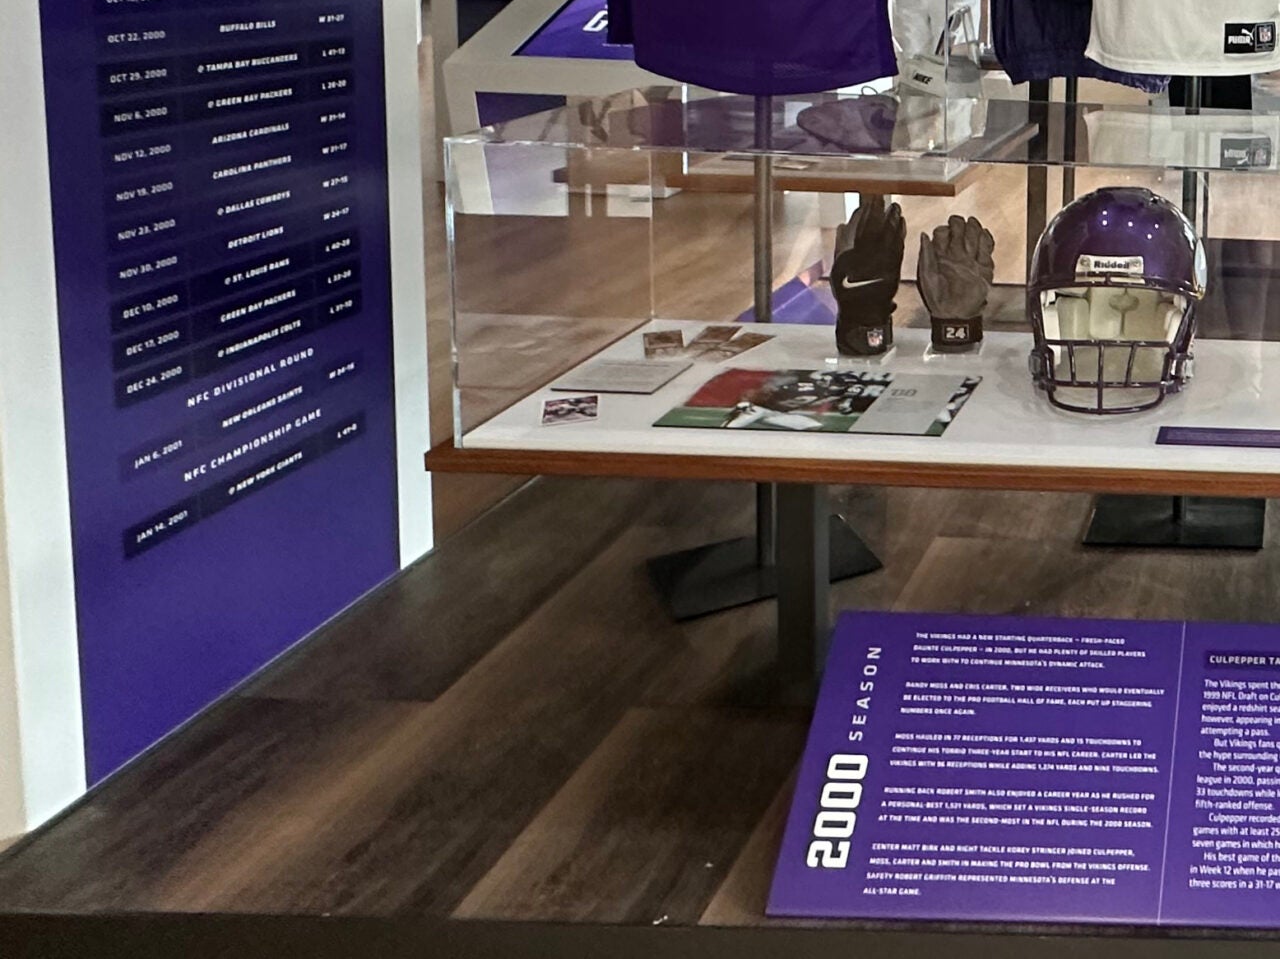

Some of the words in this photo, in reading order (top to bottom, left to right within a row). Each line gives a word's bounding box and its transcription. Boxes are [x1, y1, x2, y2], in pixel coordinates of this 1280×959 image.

[1228, 35, 1250, 45] PUMA
[912, 70, 933, 85] NIKE
[1094, 260, 1130, 269] Riddell
[946, 327, 966, 339] 24
[187, 391, 209, 407] NFC
[213, 364, 276, 396] DIVISIONAL
[279, 347, 314, 368] ROUND
[184, 464, 206, 482] NFC
[210, 423, 292, 469] CHAMPIONSHIP
[295, 408, 321, 427] GAME
[1209, 655, 1266, 665] CULPEPPER
[806, 753, 870, 869] 2000
[848, 646, 882, 742] SEASON
